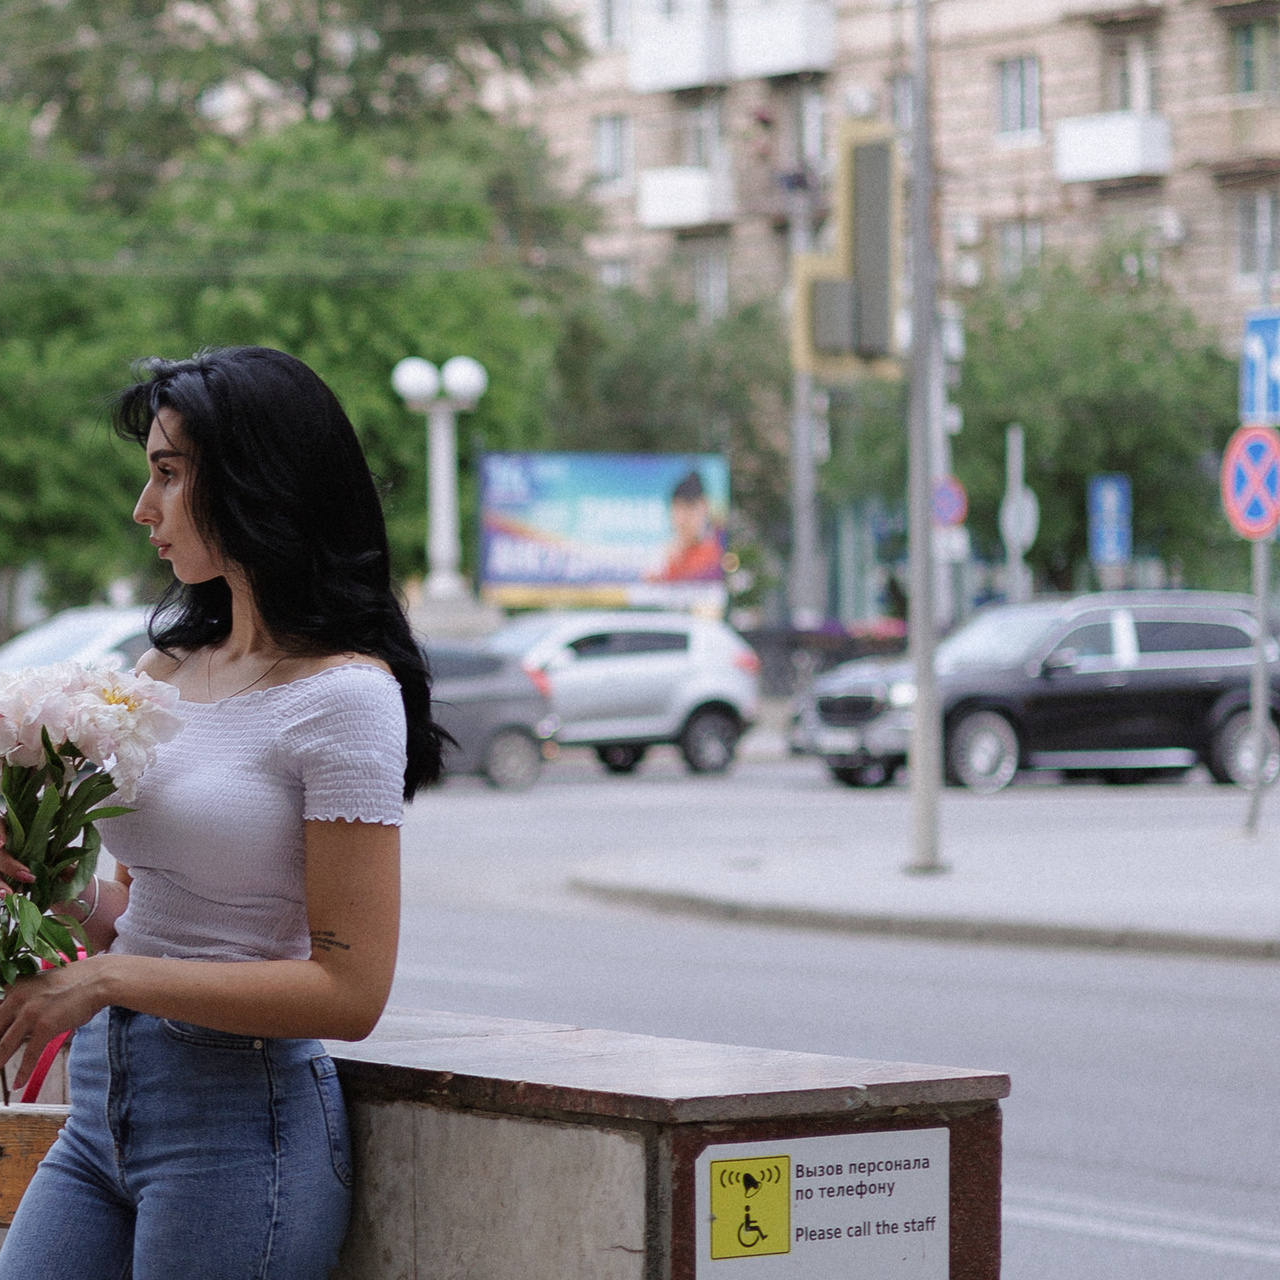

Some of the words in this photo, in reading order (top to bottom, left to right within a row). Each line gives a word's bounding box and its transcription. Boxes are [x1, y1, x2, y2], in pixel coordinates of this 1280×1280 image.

[795, 1163, 843, 1178] Вызов
[848, 1157, 930, 1175] персонала
[795, 1186, 814, 1200] по
[818, 1180, 896, 1200] телефону
[795, 1226, 842, 1242] Please
[846, 1221, 871, 1237] call
[875, 1219, 899, 1235] the
[903, 1216, 937, 1233] staff
